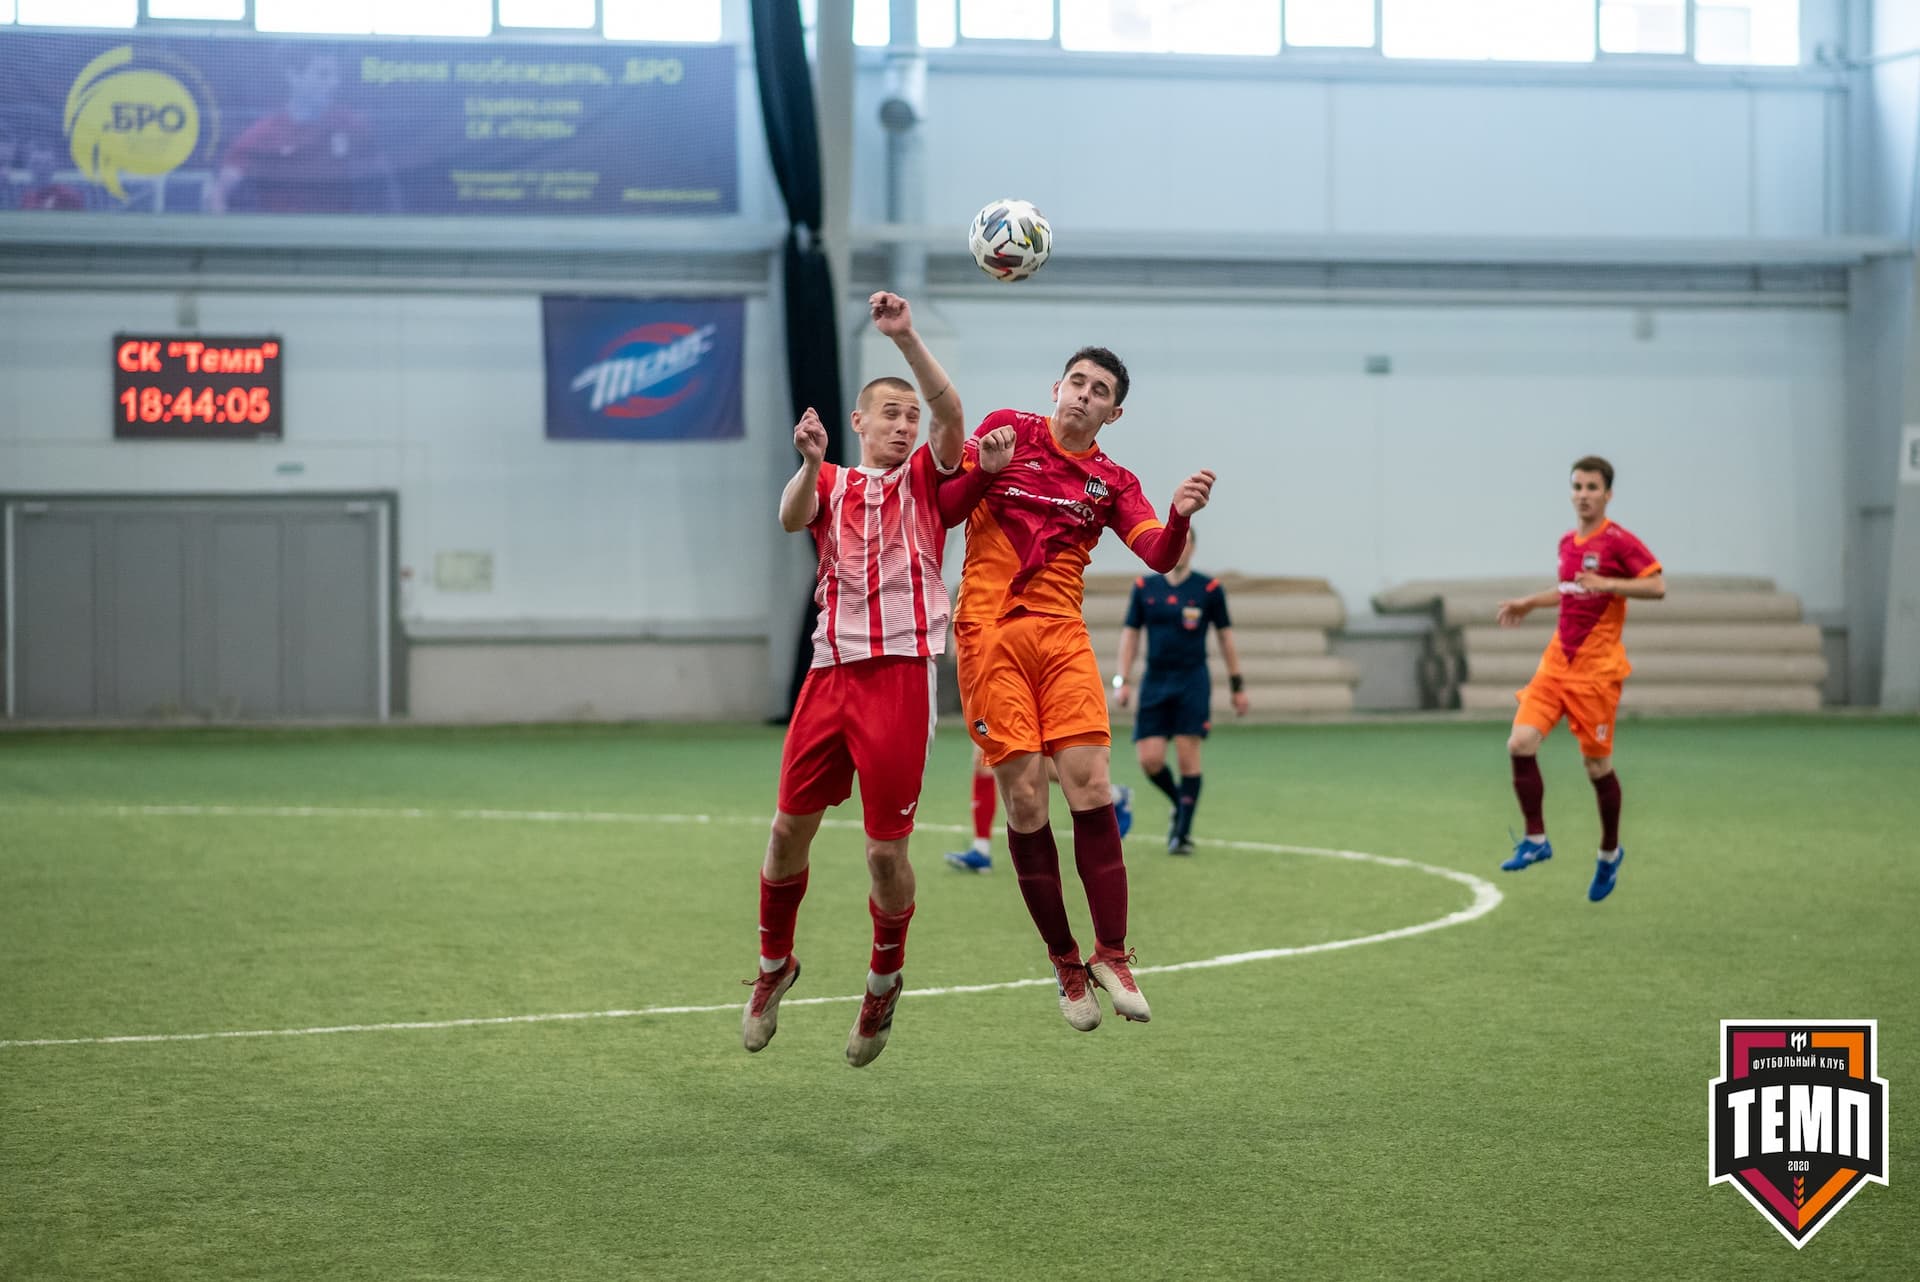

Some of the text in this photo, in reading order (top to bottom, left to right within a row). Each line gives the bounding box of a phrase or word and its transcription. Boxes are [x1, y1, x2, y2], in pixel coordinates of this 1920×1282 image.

[361, 56, 449, 86] Время
[102, 102, 186, 134] .БРО
[117, 340, 279, 374] СК "Темп"
[120, 386, 271, 423] 18:44:05
